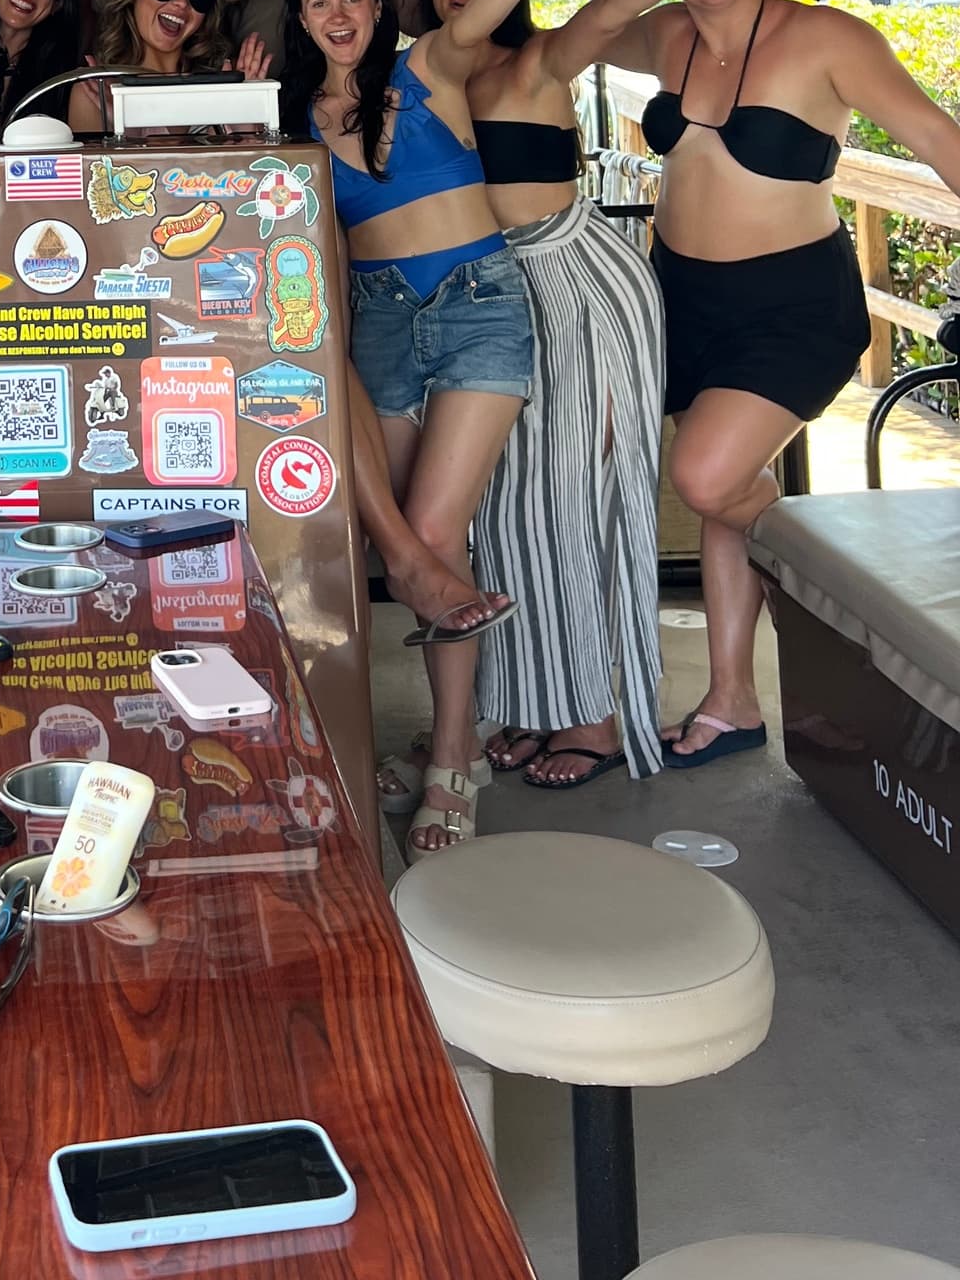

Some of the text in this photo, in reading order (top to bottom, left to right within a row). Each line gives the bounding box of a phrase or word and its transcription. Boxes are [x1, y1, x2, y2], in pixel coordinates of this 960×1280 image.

[31, 160, 54, 169] SALTY
[31, 169, 53, 177] CREW
[164, 169, 257, 195] Siesta Key
[135, 275, 170, 293] SIESTA
[234, 299, 251, 309] KEY
[18, 307, 52, 321] Crew
[53, 306, 85, 320] Have
[86, 305, 111, 319] The
[112, 305, 146, 321] Right
[19, 323, 80, 341] Alcohol
[82, 321, 147, 340] Service!
[50, 347, 58, 355] so
[86, 346, 103, 354] have
[165, 361, 188, 369] FOLLOW
[189, 361, 197, 369] US
[143, 376, 231, 403] Instagram
[12, 458, 57, 469] SCAN ME
[262, 441, 331, 491] COASTAL CONSERVATION
[268, 493, 325, 513] ASSOCIATION
[280, 489, 314, 501] FLORIDA
[100, 498, 240, 511] CAPTAINS FOR
[89, 777, 131, 800] HAWAIIAN
[873, 759, 952, 853] 10 ADULT
[74, 835, 96, 854] 50
